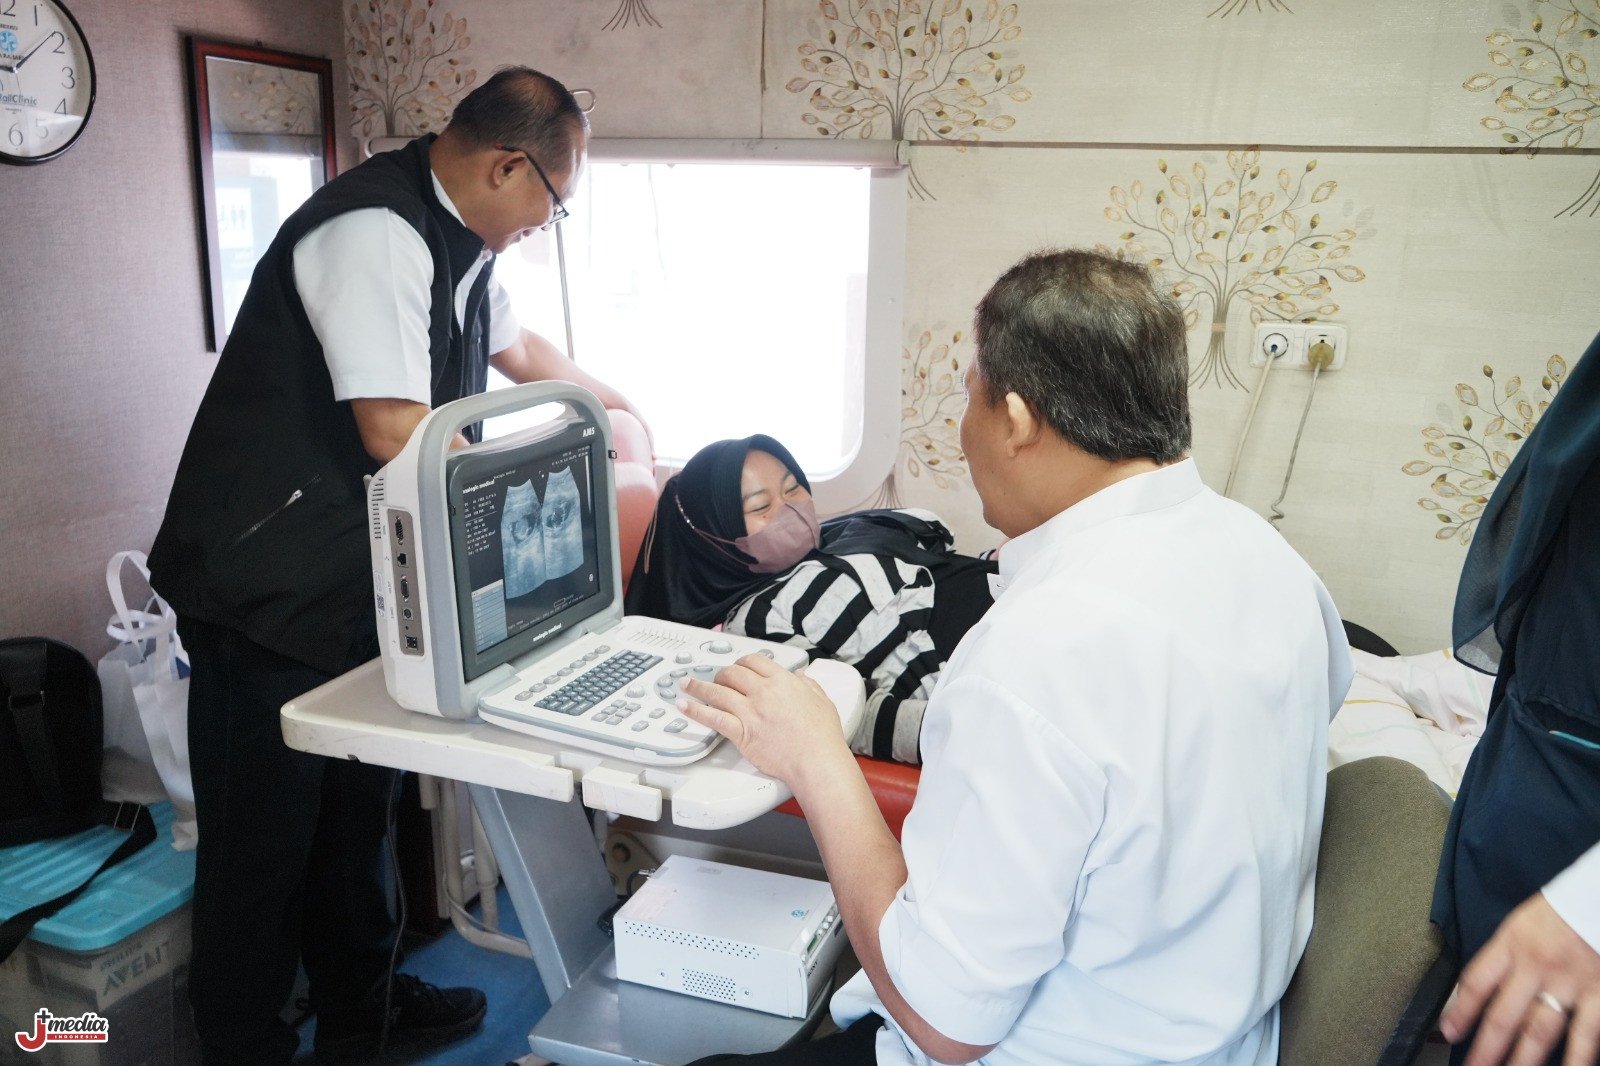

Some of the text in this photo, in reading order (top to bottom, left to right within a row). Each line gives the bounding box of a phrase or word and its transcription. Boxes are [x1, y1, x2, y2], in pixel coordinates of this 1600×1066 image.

[34, 5, 39, 27] 1
[52, 31, 66, 55] 2
[61, 66, 76, 90] 3
[54, 98, 68, 116] 4
[8, 122, 24, 147] 6
[35, 118, 49, 139] 5
[102, 941, 169, 996] AVENT
